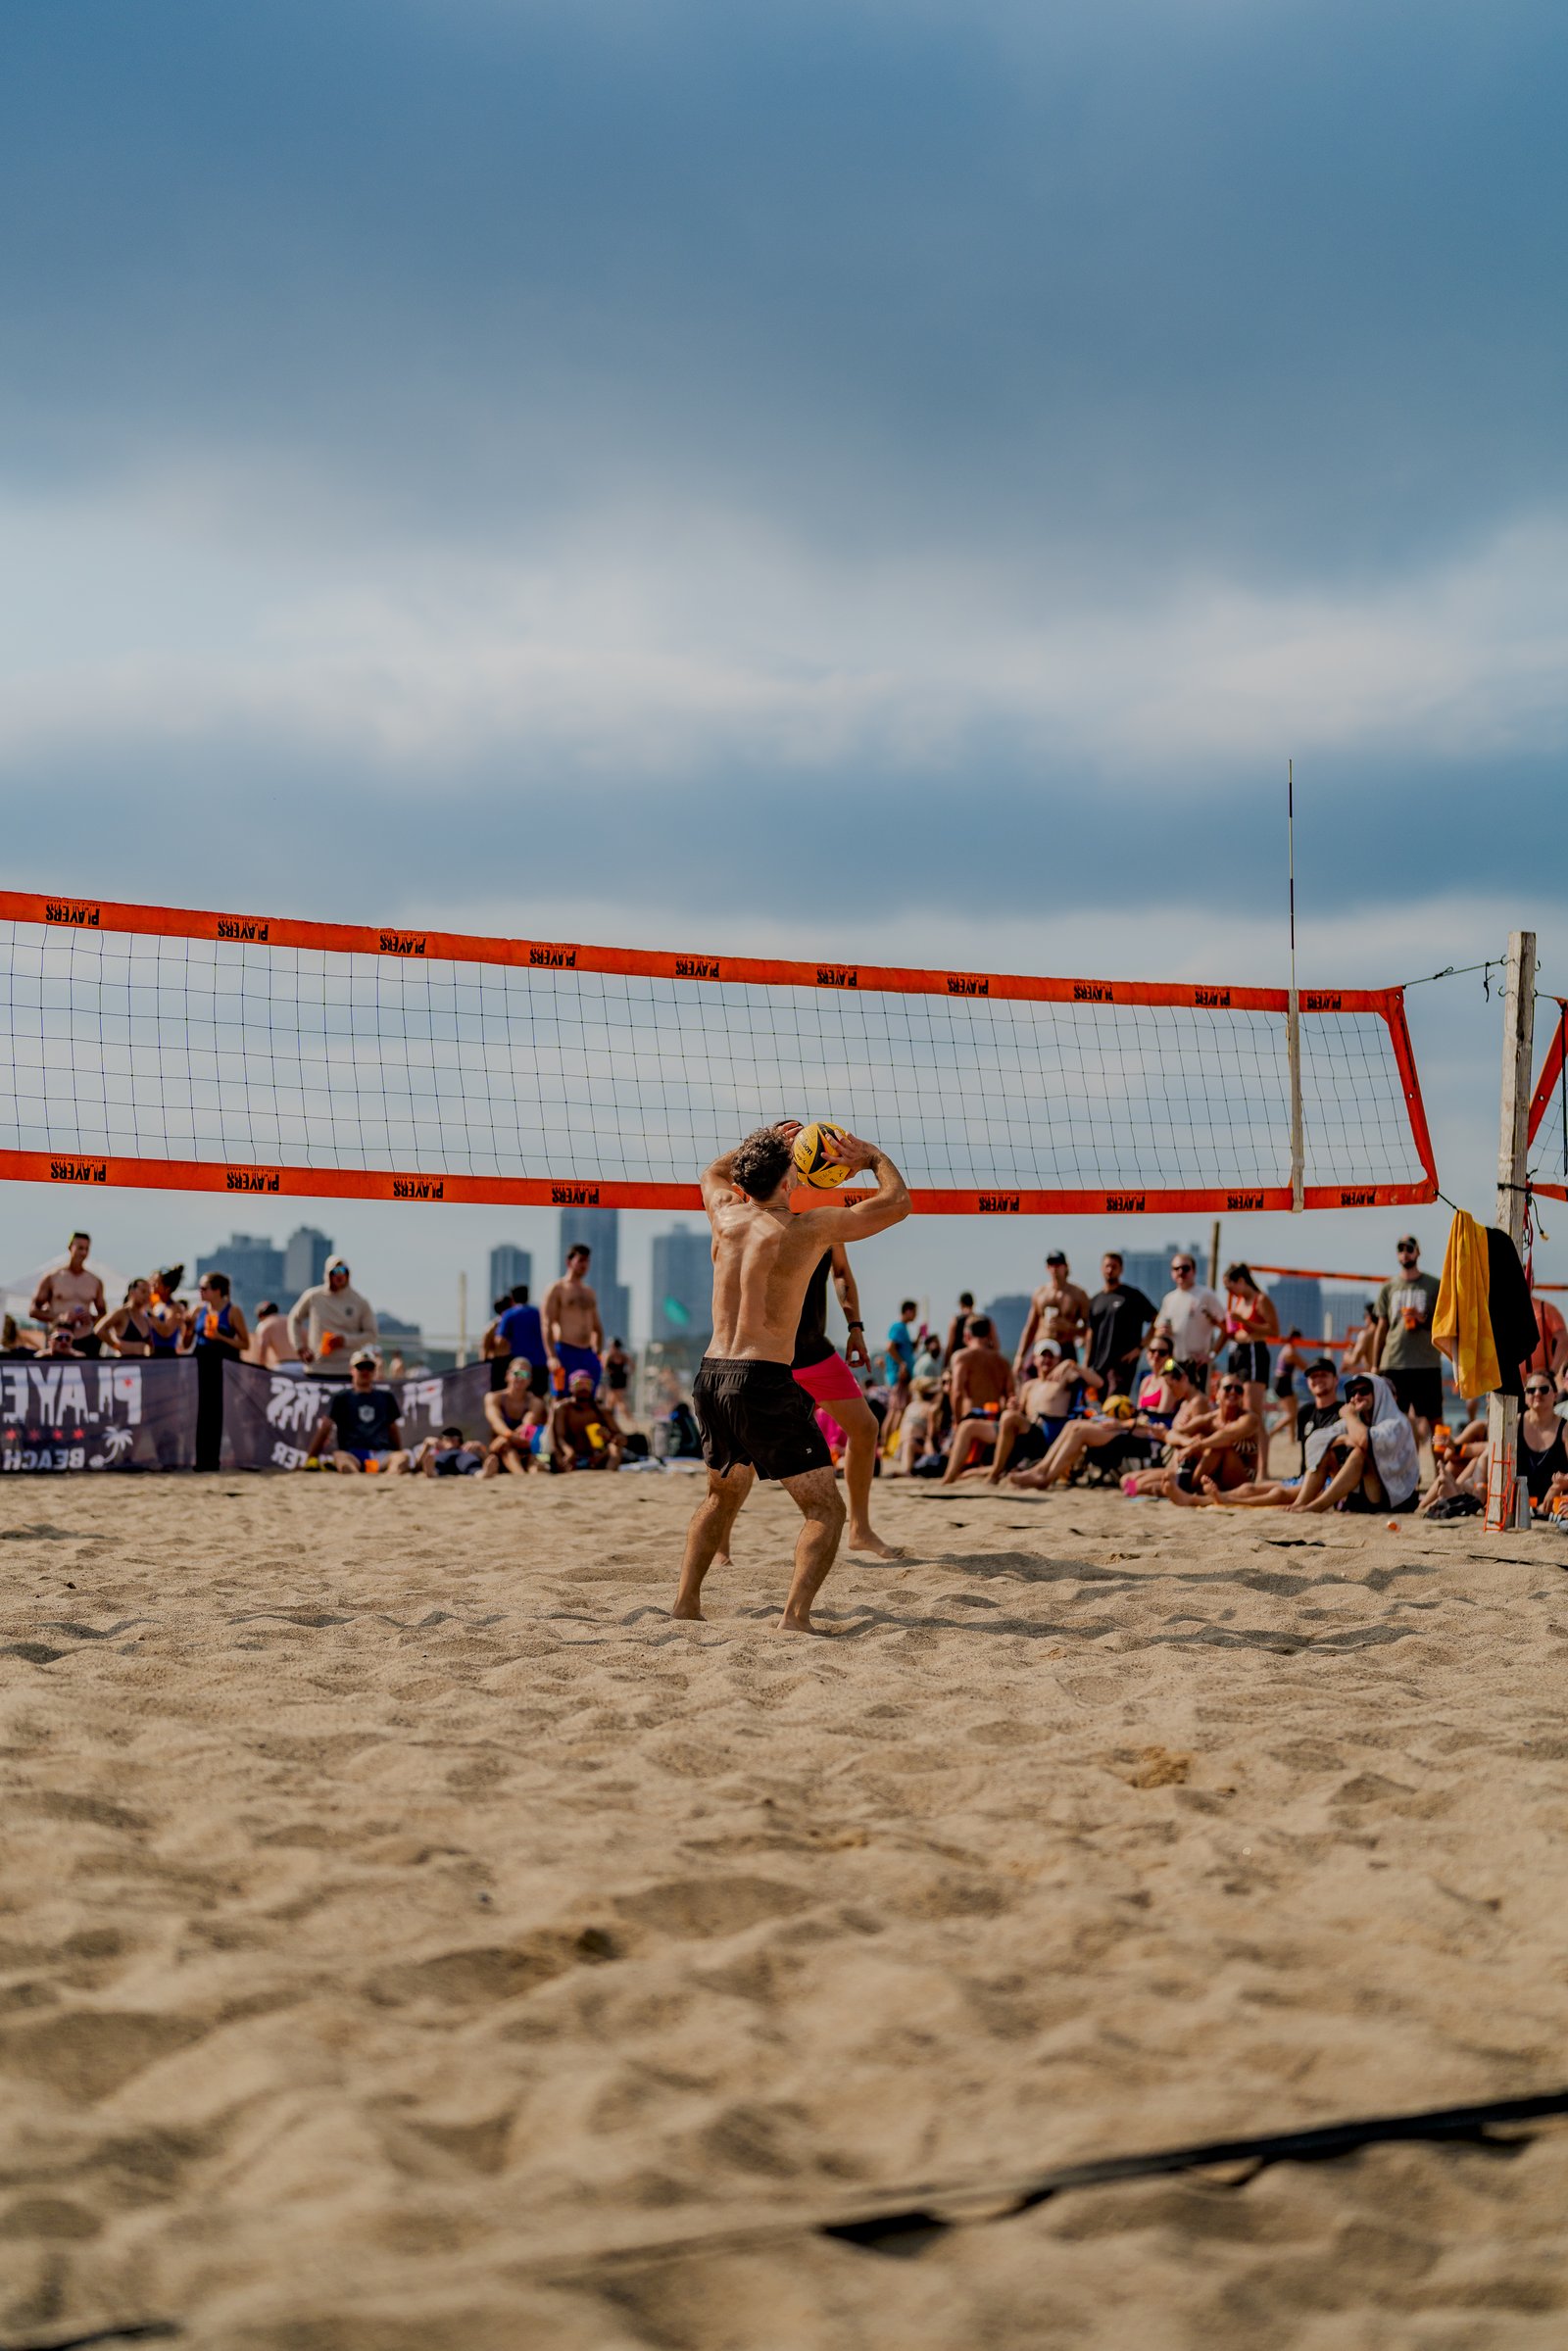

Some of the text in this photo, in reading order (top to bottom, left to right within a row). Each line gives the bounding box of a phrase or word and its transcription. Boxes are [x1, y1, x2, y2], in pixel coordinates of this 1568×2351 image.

[45, 904, 100, 926] PLAYERS
[218, 920, 269, 942] PLAYERS
[379, 935, 426, 955] PLAYERS
[529, 948, 576, 967] PLAYERS
[675, 960, 720, 978] PLAYERS
[816, 969, 858, 988] PLAYERS
[947, 978, 989, 996] PLAYERS
[1073, 986, 1114, 1002] PLAYERS
[1195, 991, 1231, 1006] PLAYERS
[1306, 995, 1342, 1010] PLAYERS
[50, 1161, 107, 1183] PLAYERS
[226, 1171, 279, 1192] PLAYERS
[393, 1180, 444, 1200] PLAYERS
[552, 1187, 600, 1205] PLAYERS
[978, 1197, 1020, 1212] PLAYERS
[1106, 1196, 1146, 1212] PLAYERS
[1227, 1194, 1264, 1210] PLAYERS
[1341, 1191, 1377, 1206] PLAYERS
